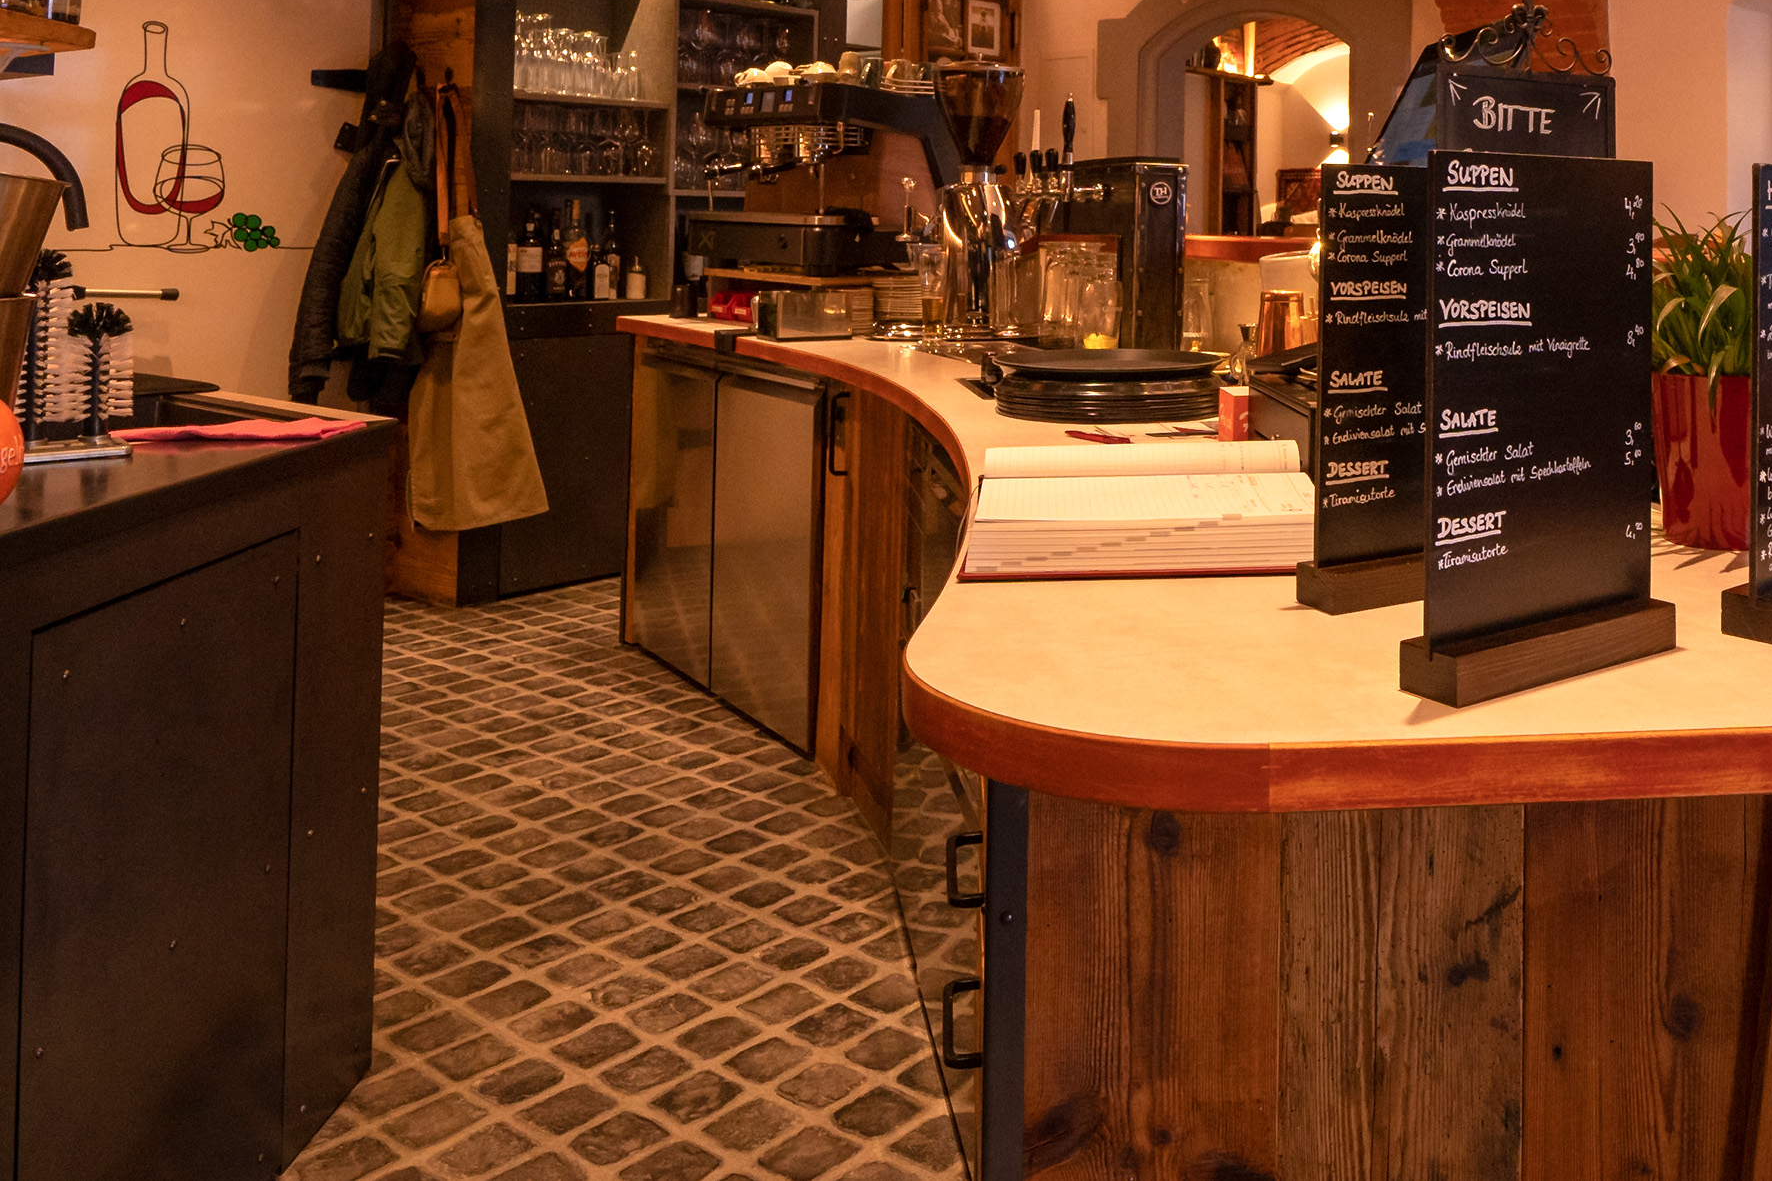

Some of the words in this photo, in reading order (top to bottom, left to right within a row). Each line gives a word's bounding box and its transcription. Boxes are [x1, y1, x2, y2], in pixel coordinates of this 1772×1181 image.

[1473, 95, 1555, 134] BITTE
[1336, 170, 1393, 190] SUPPEN
[1447, 160, 1513, 186] SUPPEN
[1450, 202, 1526, 229] Kaspressknödel
[1337, 229, 1413, 250] Grammelknödel
[1446, 233, 1516, 257] Grammelknödel
[1337, 249, 1368, 263] Corona
[1372, 250, 1408, 266] Supperl
[1447, 259, 1484, 277] Corona
[1489, 258, 1528, 281] Supperl
[1331, 280, 1407, 296] VORSPEISEN
[1439, 298, 1531, 320] VORSPEISEN
[1445, 341, 1523, 362] Rindfleischsulz
[1529, 338, 1544, 353] mit
[1546, 336, 1590, 358] Vinaigrette
[1330, 370, 1383, 388] SALATE
[1333, 403, 1387, 425] Gemischter
[1394, 401, 1422, 416] Salat
[1440, 409, 1497, 431] SALATE
[1332, 424, 1395, 445] Endiviensalat
[1400, 422, 1415, 437] mit
[1327, 460, 1389, 478] DESSERT
[1446, 446, 1498, 475] Gemischter
[1504, 441, 1534, 460] Salat
[1447, 470, 1506, 496] Endiviensalat
[1511, 467, 1525, 484] mit
[1329, 486, 1396, 508] Tiramisutorte
[1437, 511, 1507, 538] DESSERT
[1443, 543, 1509, 569] Tiramisutorte
